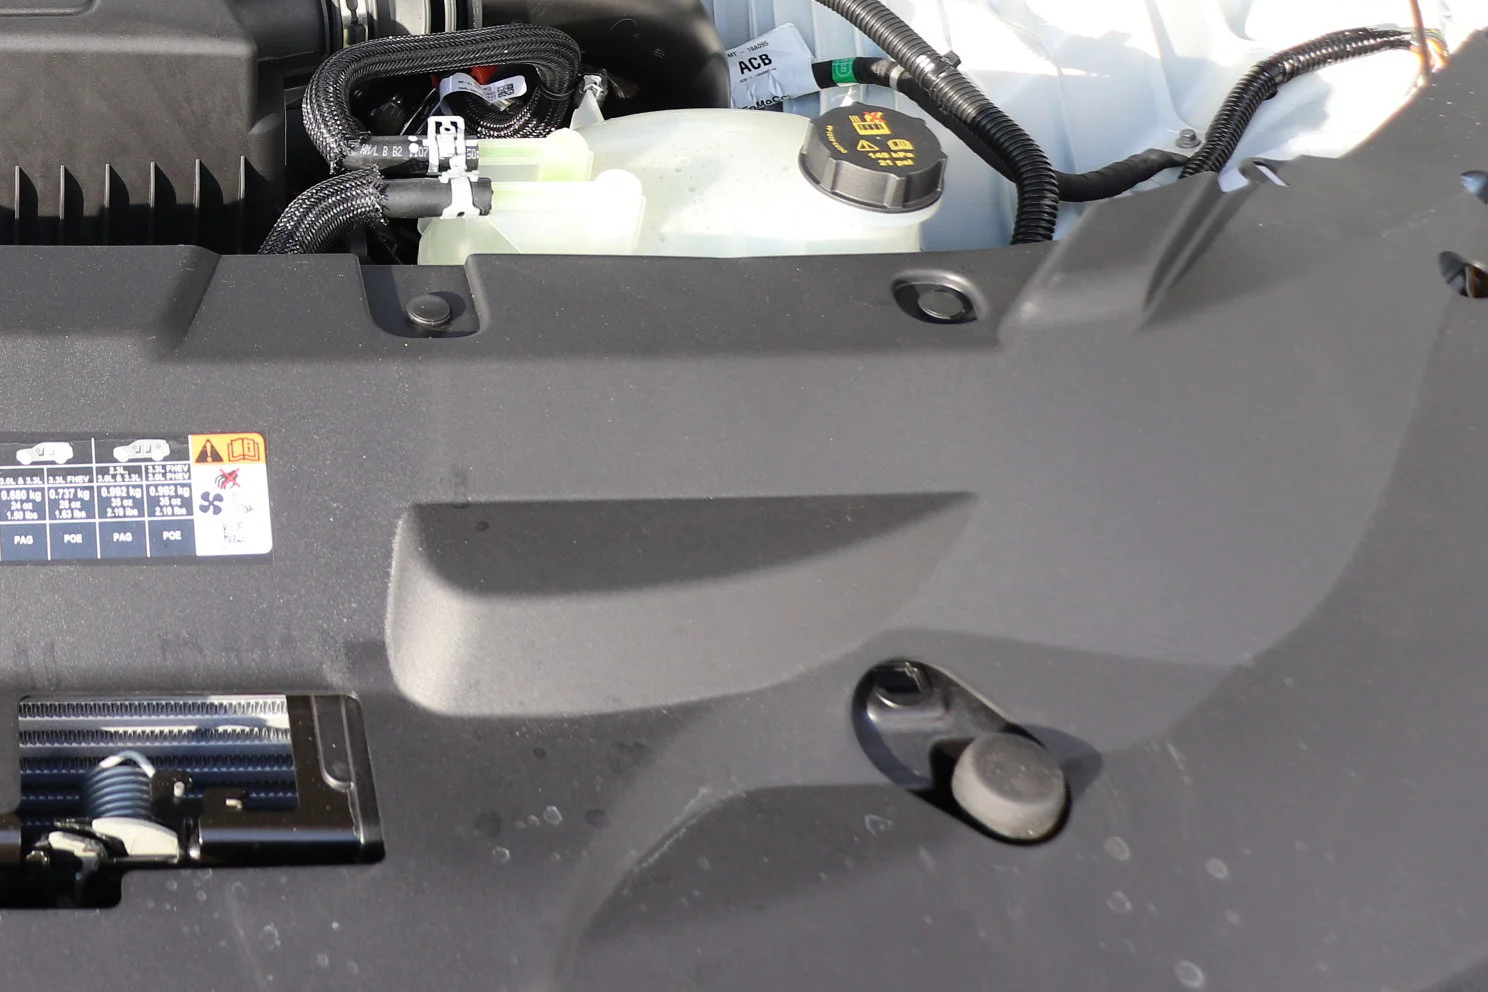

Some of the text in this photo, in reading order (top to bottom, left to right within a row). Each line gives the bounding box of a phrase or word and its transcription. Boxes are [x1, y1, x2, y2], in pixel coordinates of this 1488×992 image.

[738, 53, 773, 75] ACB
[409, 146, 429, 157] 07
[26, 476, 43, 484] 3.3L
[48, 476, 65, 484] 3.3L
[29, 489, 42, 502] kg
[49, 488, 90, 501] 0.737 kg
[129, 486, 142, 498] kg
[177, 485, 190, 498] kg
[10, 501, 33, 510] 24 oz
[73, 510, 86, 518] lbs
[125, 508, 138, 516] lbs
[173, 506, 187, 515] lbs
[25, 511, 38, 520] lbs
[14, 535, 33, 545] PAG
[64, 534, 83, 543] POE
[113, 532, 132, 542] PAG
[163, 531, 182, 540] POE
